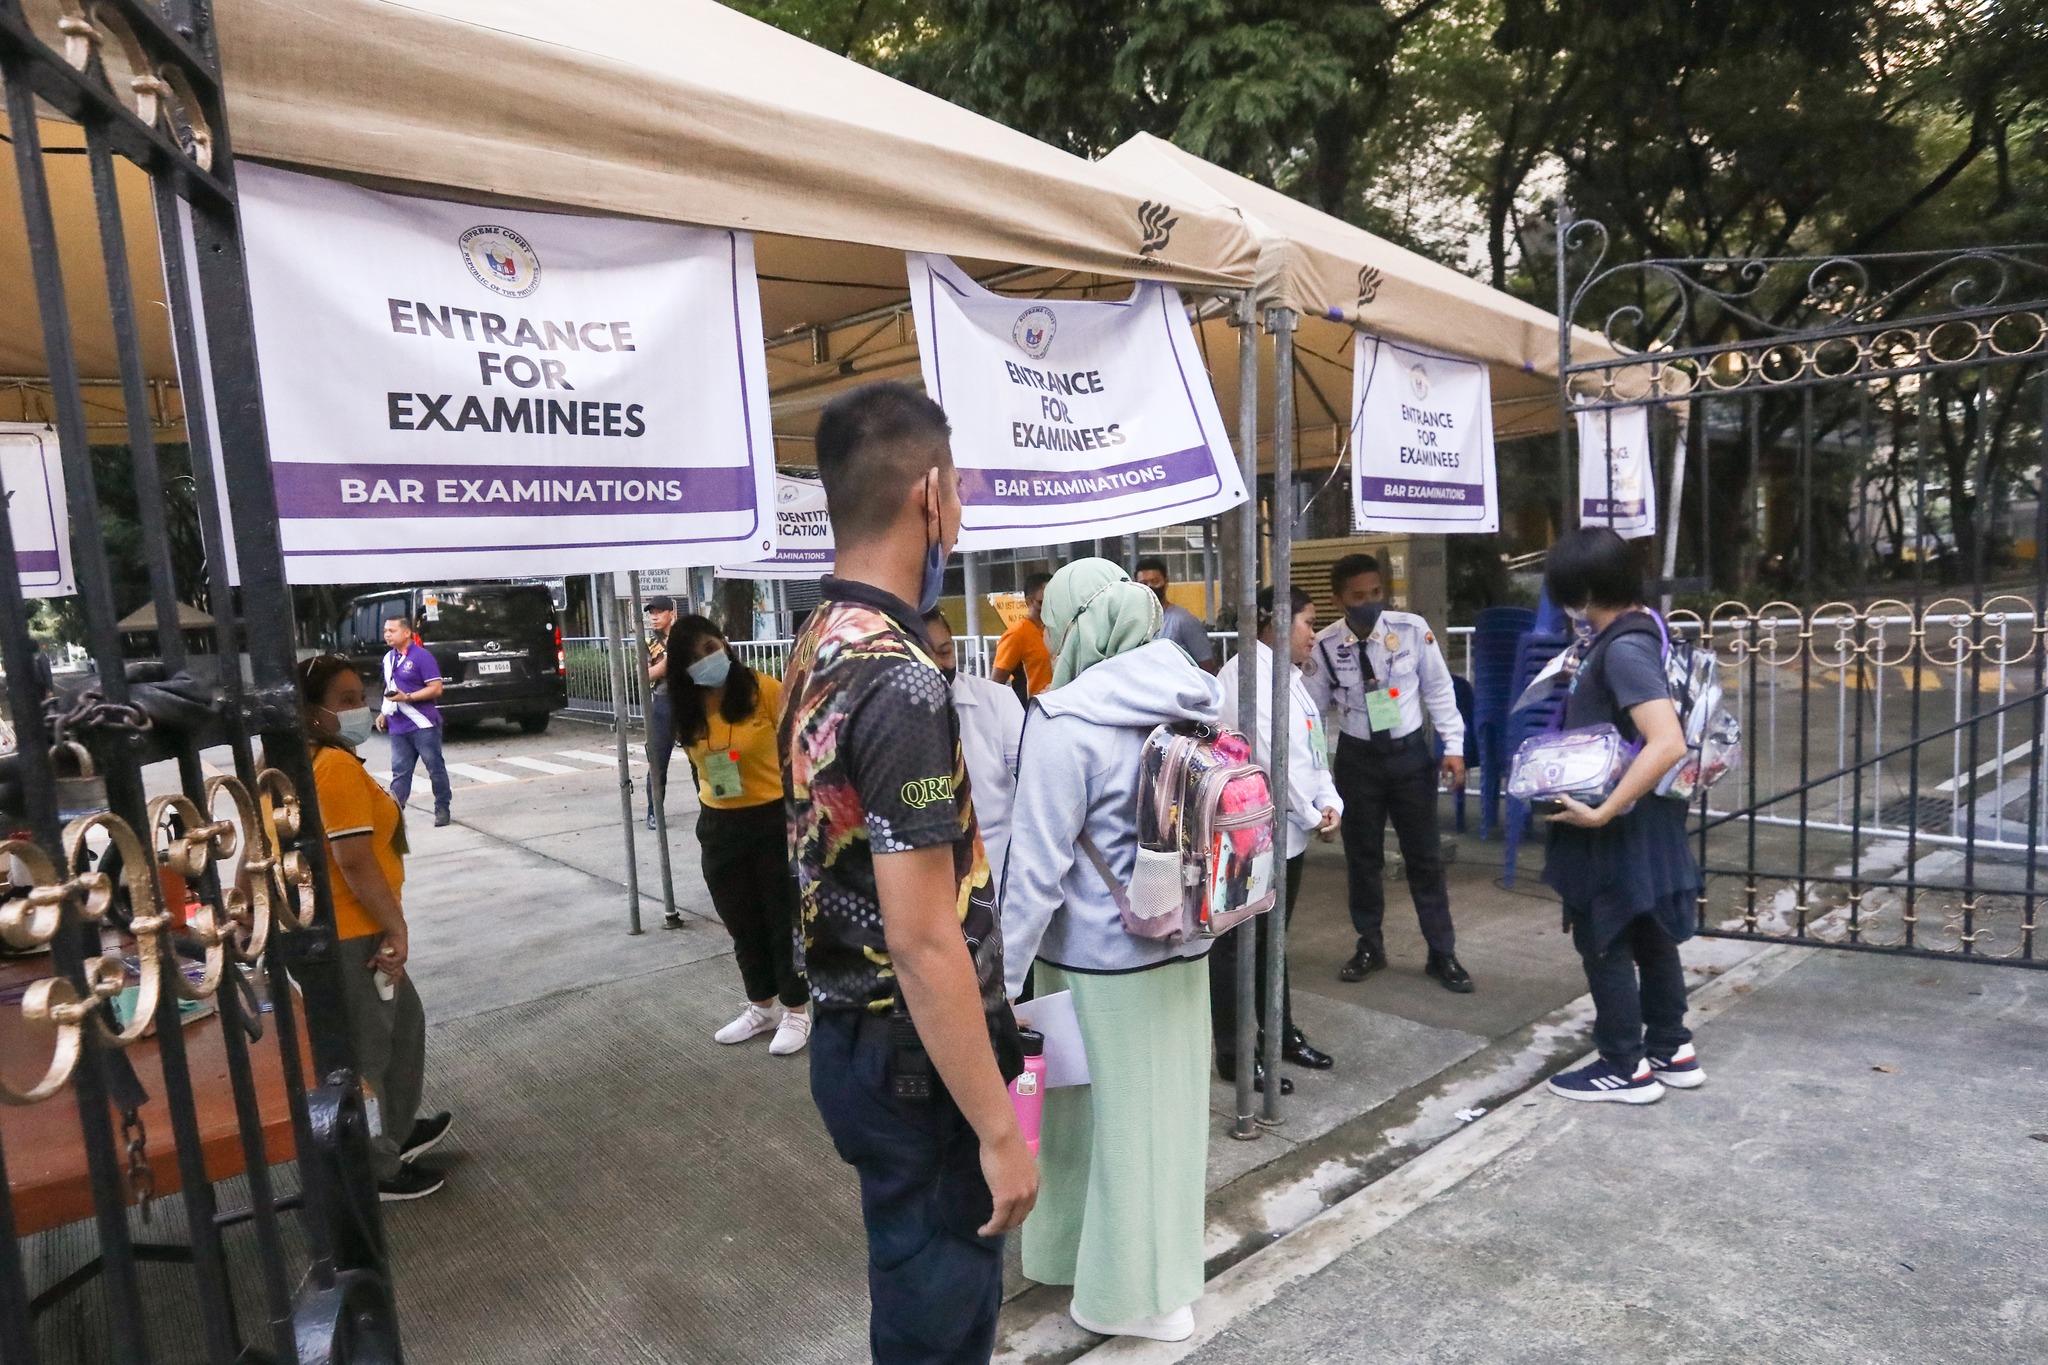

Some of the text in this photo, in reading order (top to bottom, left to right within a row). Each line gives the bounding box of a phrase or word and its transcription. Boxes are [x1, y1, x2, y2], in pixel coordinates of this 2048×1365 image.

[462, 227, 531, 254] SUPREME COURT
[464, 252, 490, 285] REPUBLIC
[502, 288, 517, 297] THE
[388, 298, 636, 353] ENTRANCE
[478, 351, 575, 390] FOR
[1005, 360, 1105, 396] ENTRANCE
[387, 391, 646, 438] EXAMINEES
[1040, 395, 1074, 424] FOR
[1401, 404, 1454, 428] ENTRANCE
[1012, 421, 1127, 451] EXAMINEES
[1417, 429, 1438, 447] FOR
[1400, 446, 1460, 468] EXAMINEES
[340, 479, 683, 503] BAR EXAMINATIONS
[994, 465, 1167, 497] BAR EXAMINATIONS
[1384, 483, 1466, 501] BAR EXAMINATIONS
[776, 510, 829, 523] IDENTITY
[777, 524, 827, 536] ICATION
[774, 552, 826, 560] AMINATIONS
[639, 576, 669, 584] FFIC RULES
